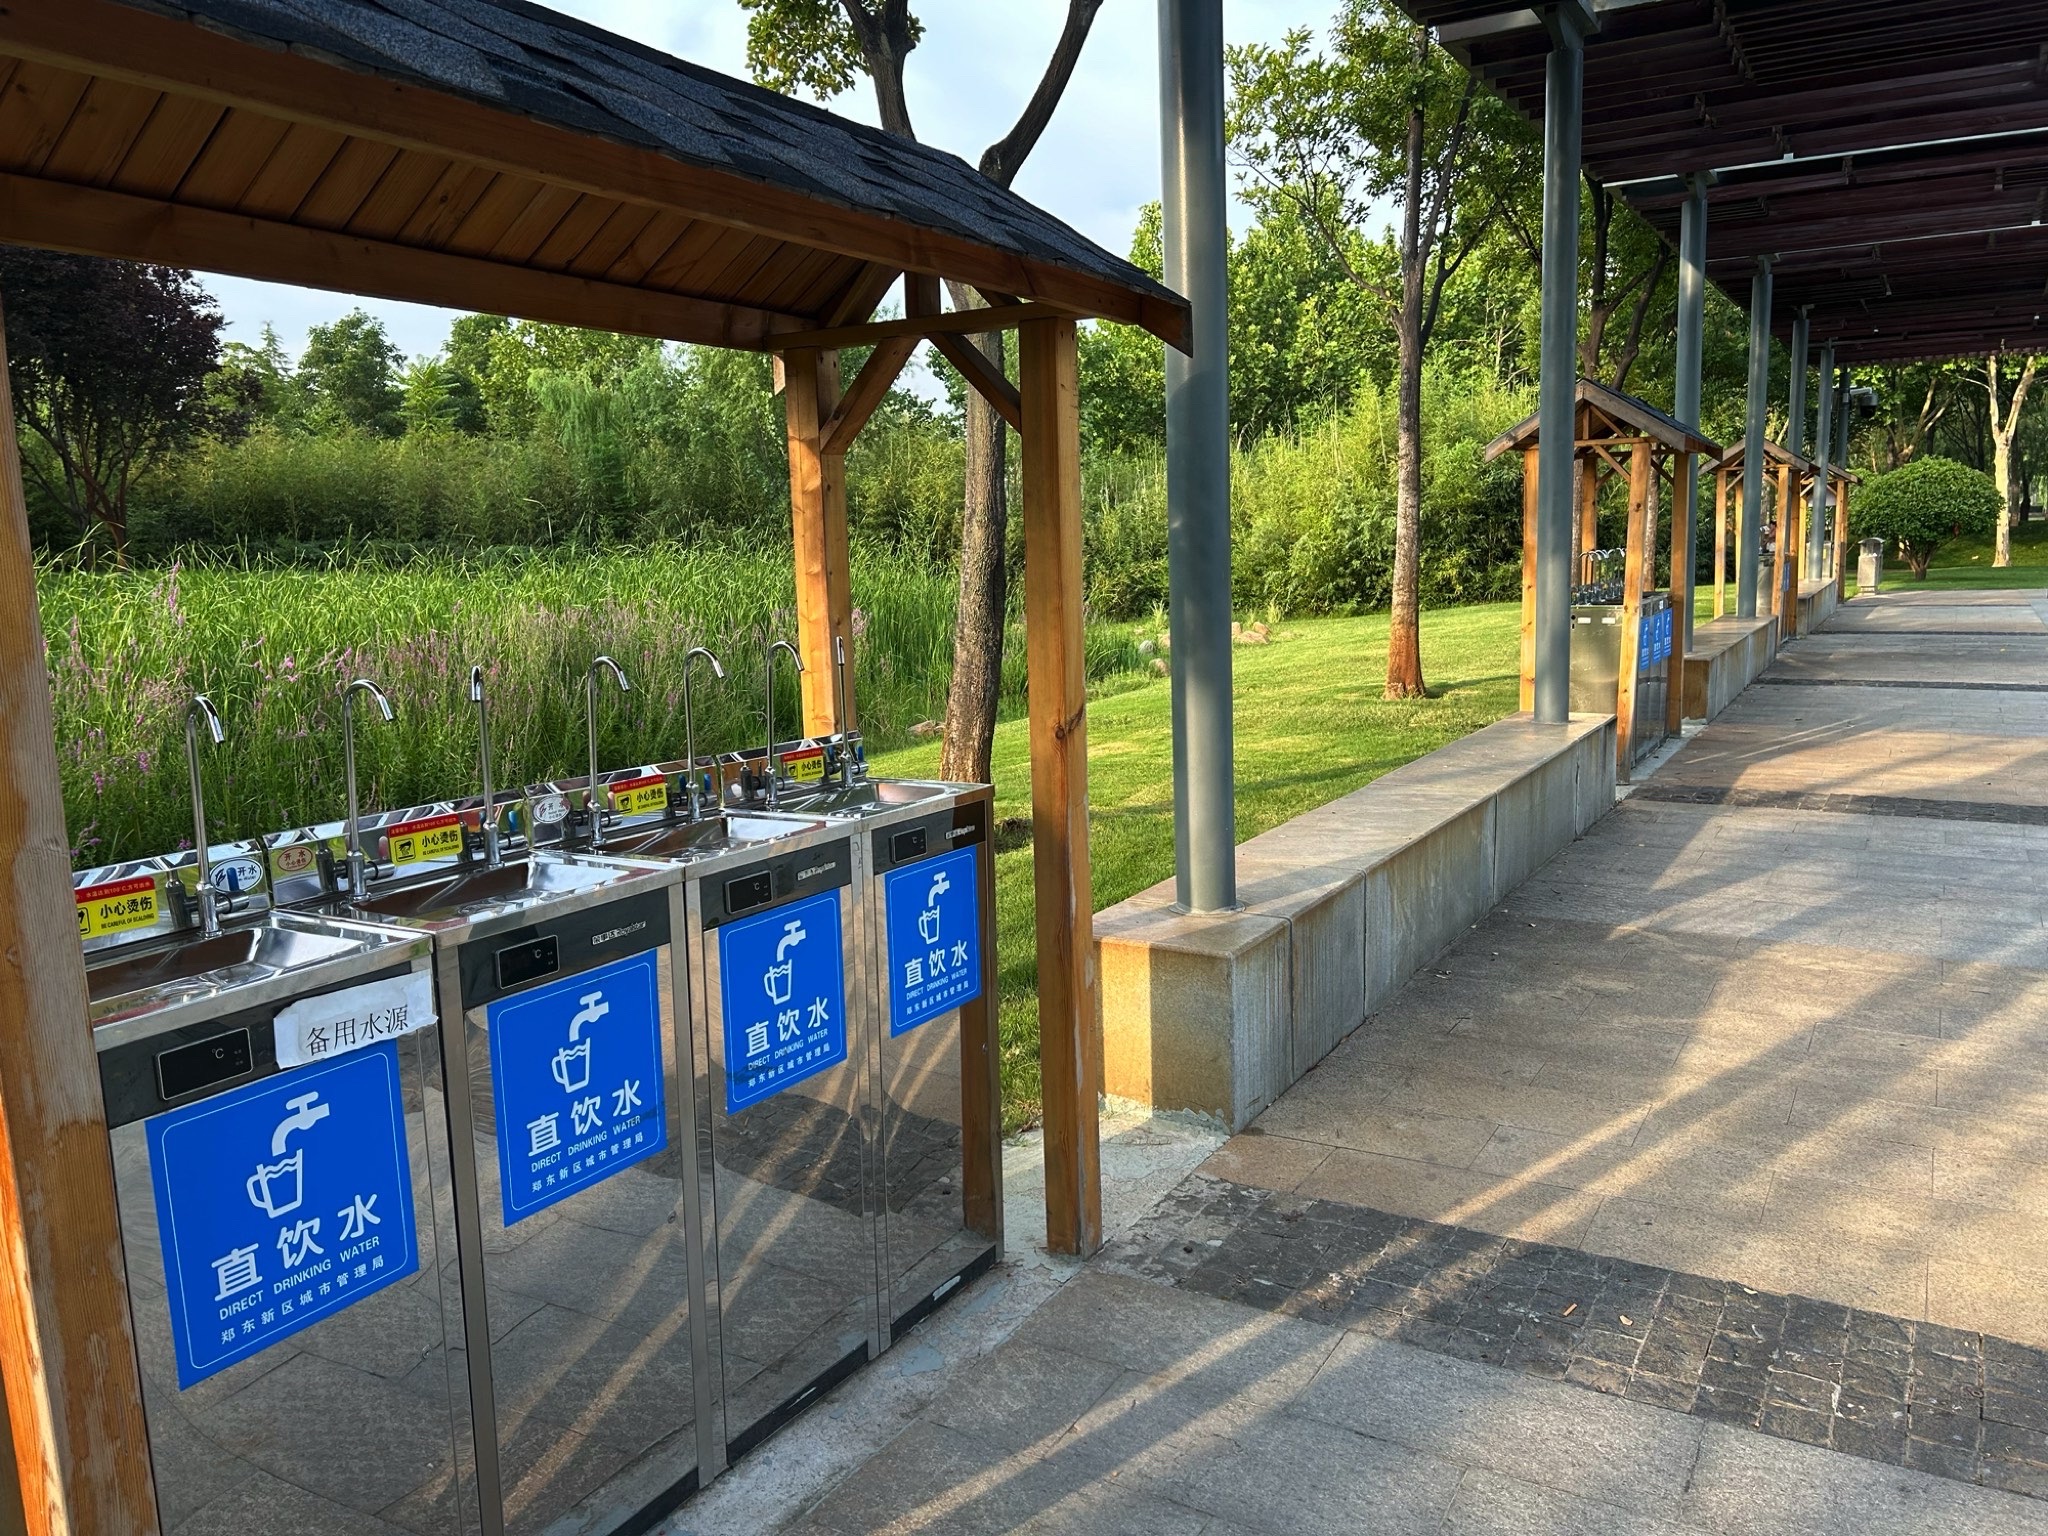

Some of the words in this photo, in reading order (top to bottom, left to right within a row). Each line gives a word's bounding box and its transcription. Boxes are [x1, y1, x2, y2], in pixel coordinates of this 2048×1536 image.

[637, 788, 663, 802] 小心烫伤
[422, 830, 458, 847] 小心烫伤
[101, 896, 152, 919] 小心烫伤
[905, 940, 968, 988] 直饮水
[906, 987, 924, 1000] DIRECT
[927, 976, 948, 991] DRINKING
[951, 968, 967, 980] WATER
[305, 1004, 408, 1056] 备用水源
[745, 996, 829, 1057] 直饮水
[748, 1055, 770, 1071] DIRECT
[774, 1040, 804, 1059] DRINKING
[808, 1029, 828, 1043] WATER
[527, 1079, 642, 1157] 直饮水
[531, 1151, 561, 1173] DIRECT
[568, 1131, 607, 1156] DRINKING
[613, 1115, 641, 1135] WATER
[532, 1132, 643, 1192] 郑东新区城市管理局
[211, 1194, 381, 1301] 直饮水
[219, 1290, 264, 1320] DIRECT
[274, 1259, 331, 1294] DRINKING
[339, 1236, 380, 1262] WATER
[222, 1255, 384, 1344] 郑东新区城市管理局
